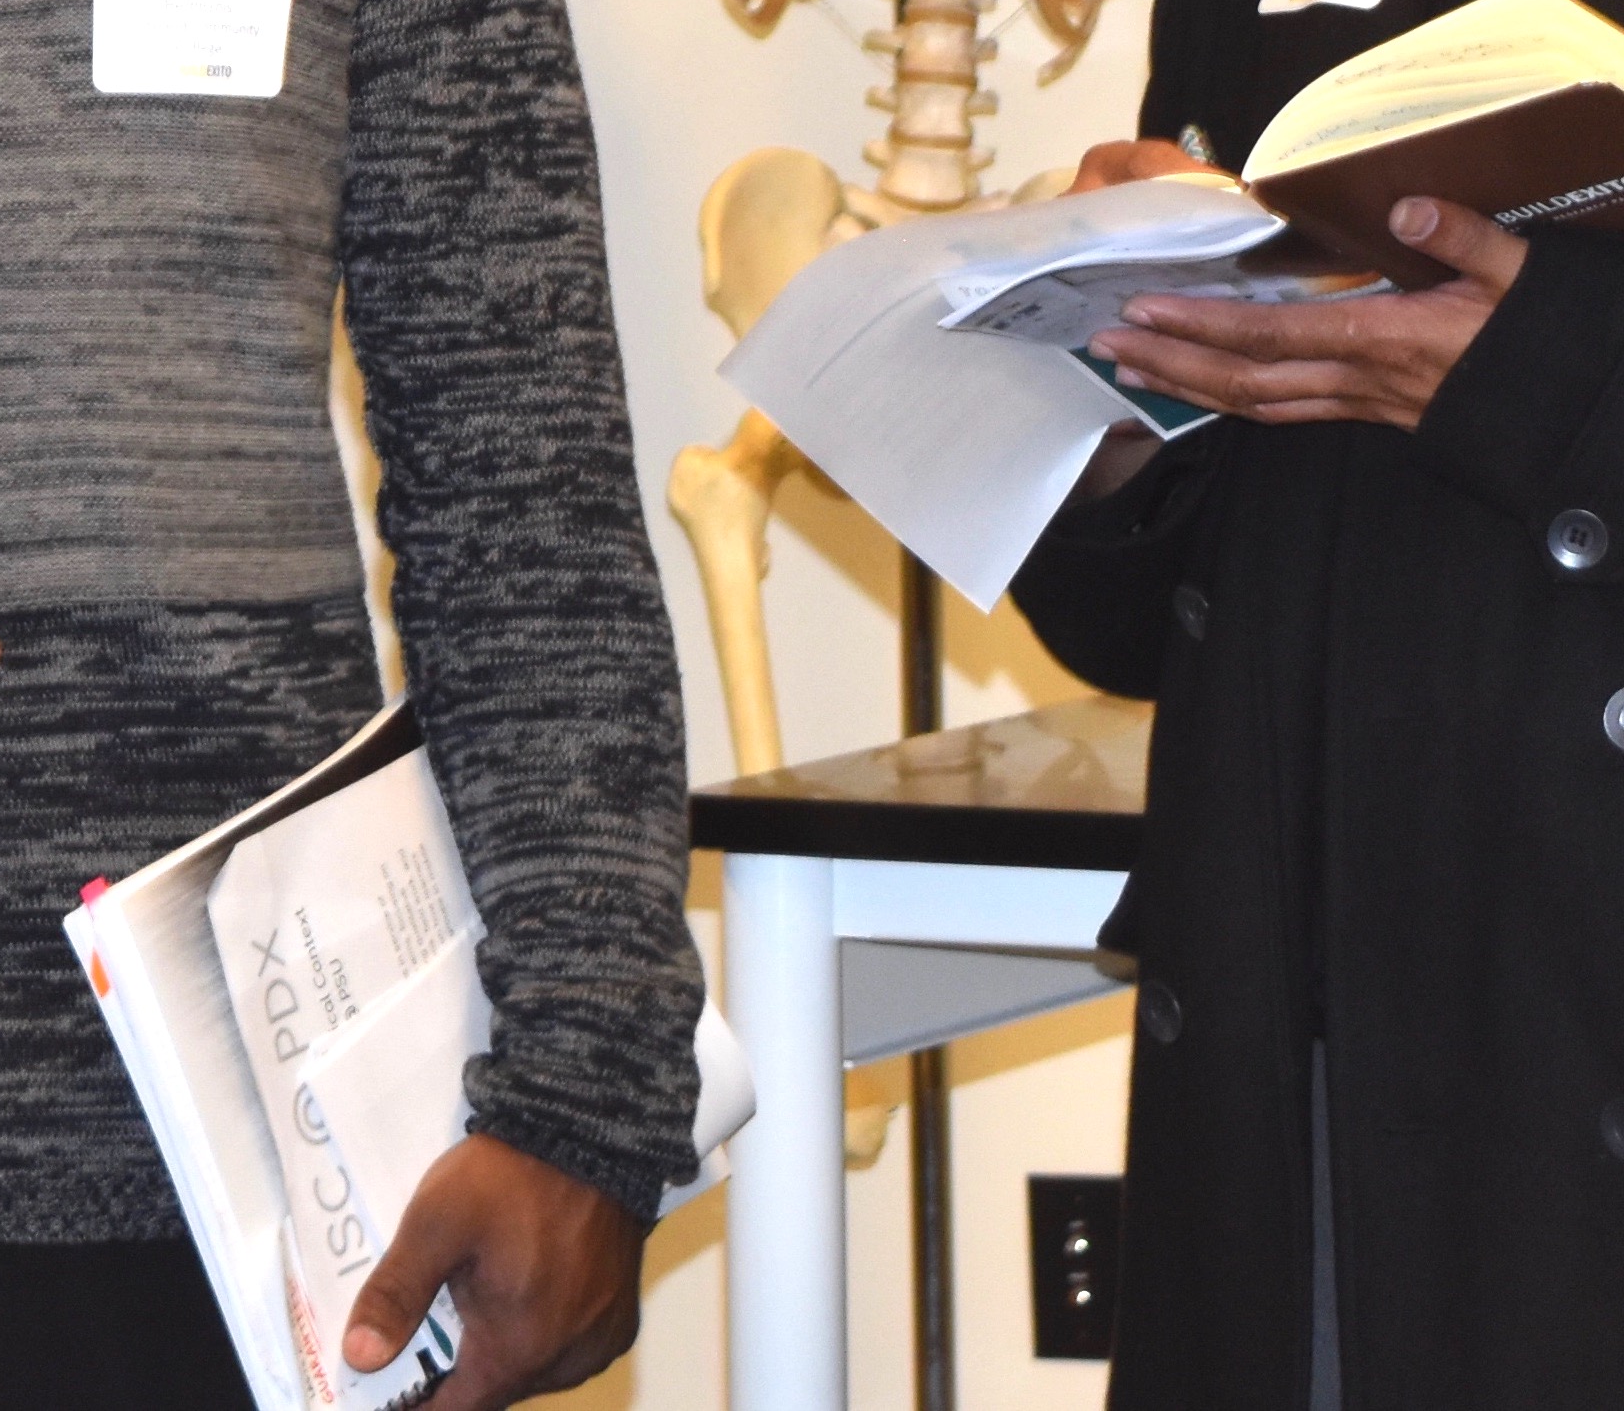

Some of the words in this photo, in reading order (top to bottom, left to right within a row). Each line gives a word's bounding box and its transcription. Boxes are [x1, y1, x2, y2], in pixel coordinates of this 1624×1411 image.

[294, 906, 327, 989] Context
[328, 957, 352, 1001] PSU
[251, 927, 310, 1064] PDX
[319, 992, 339, 1032] ical
